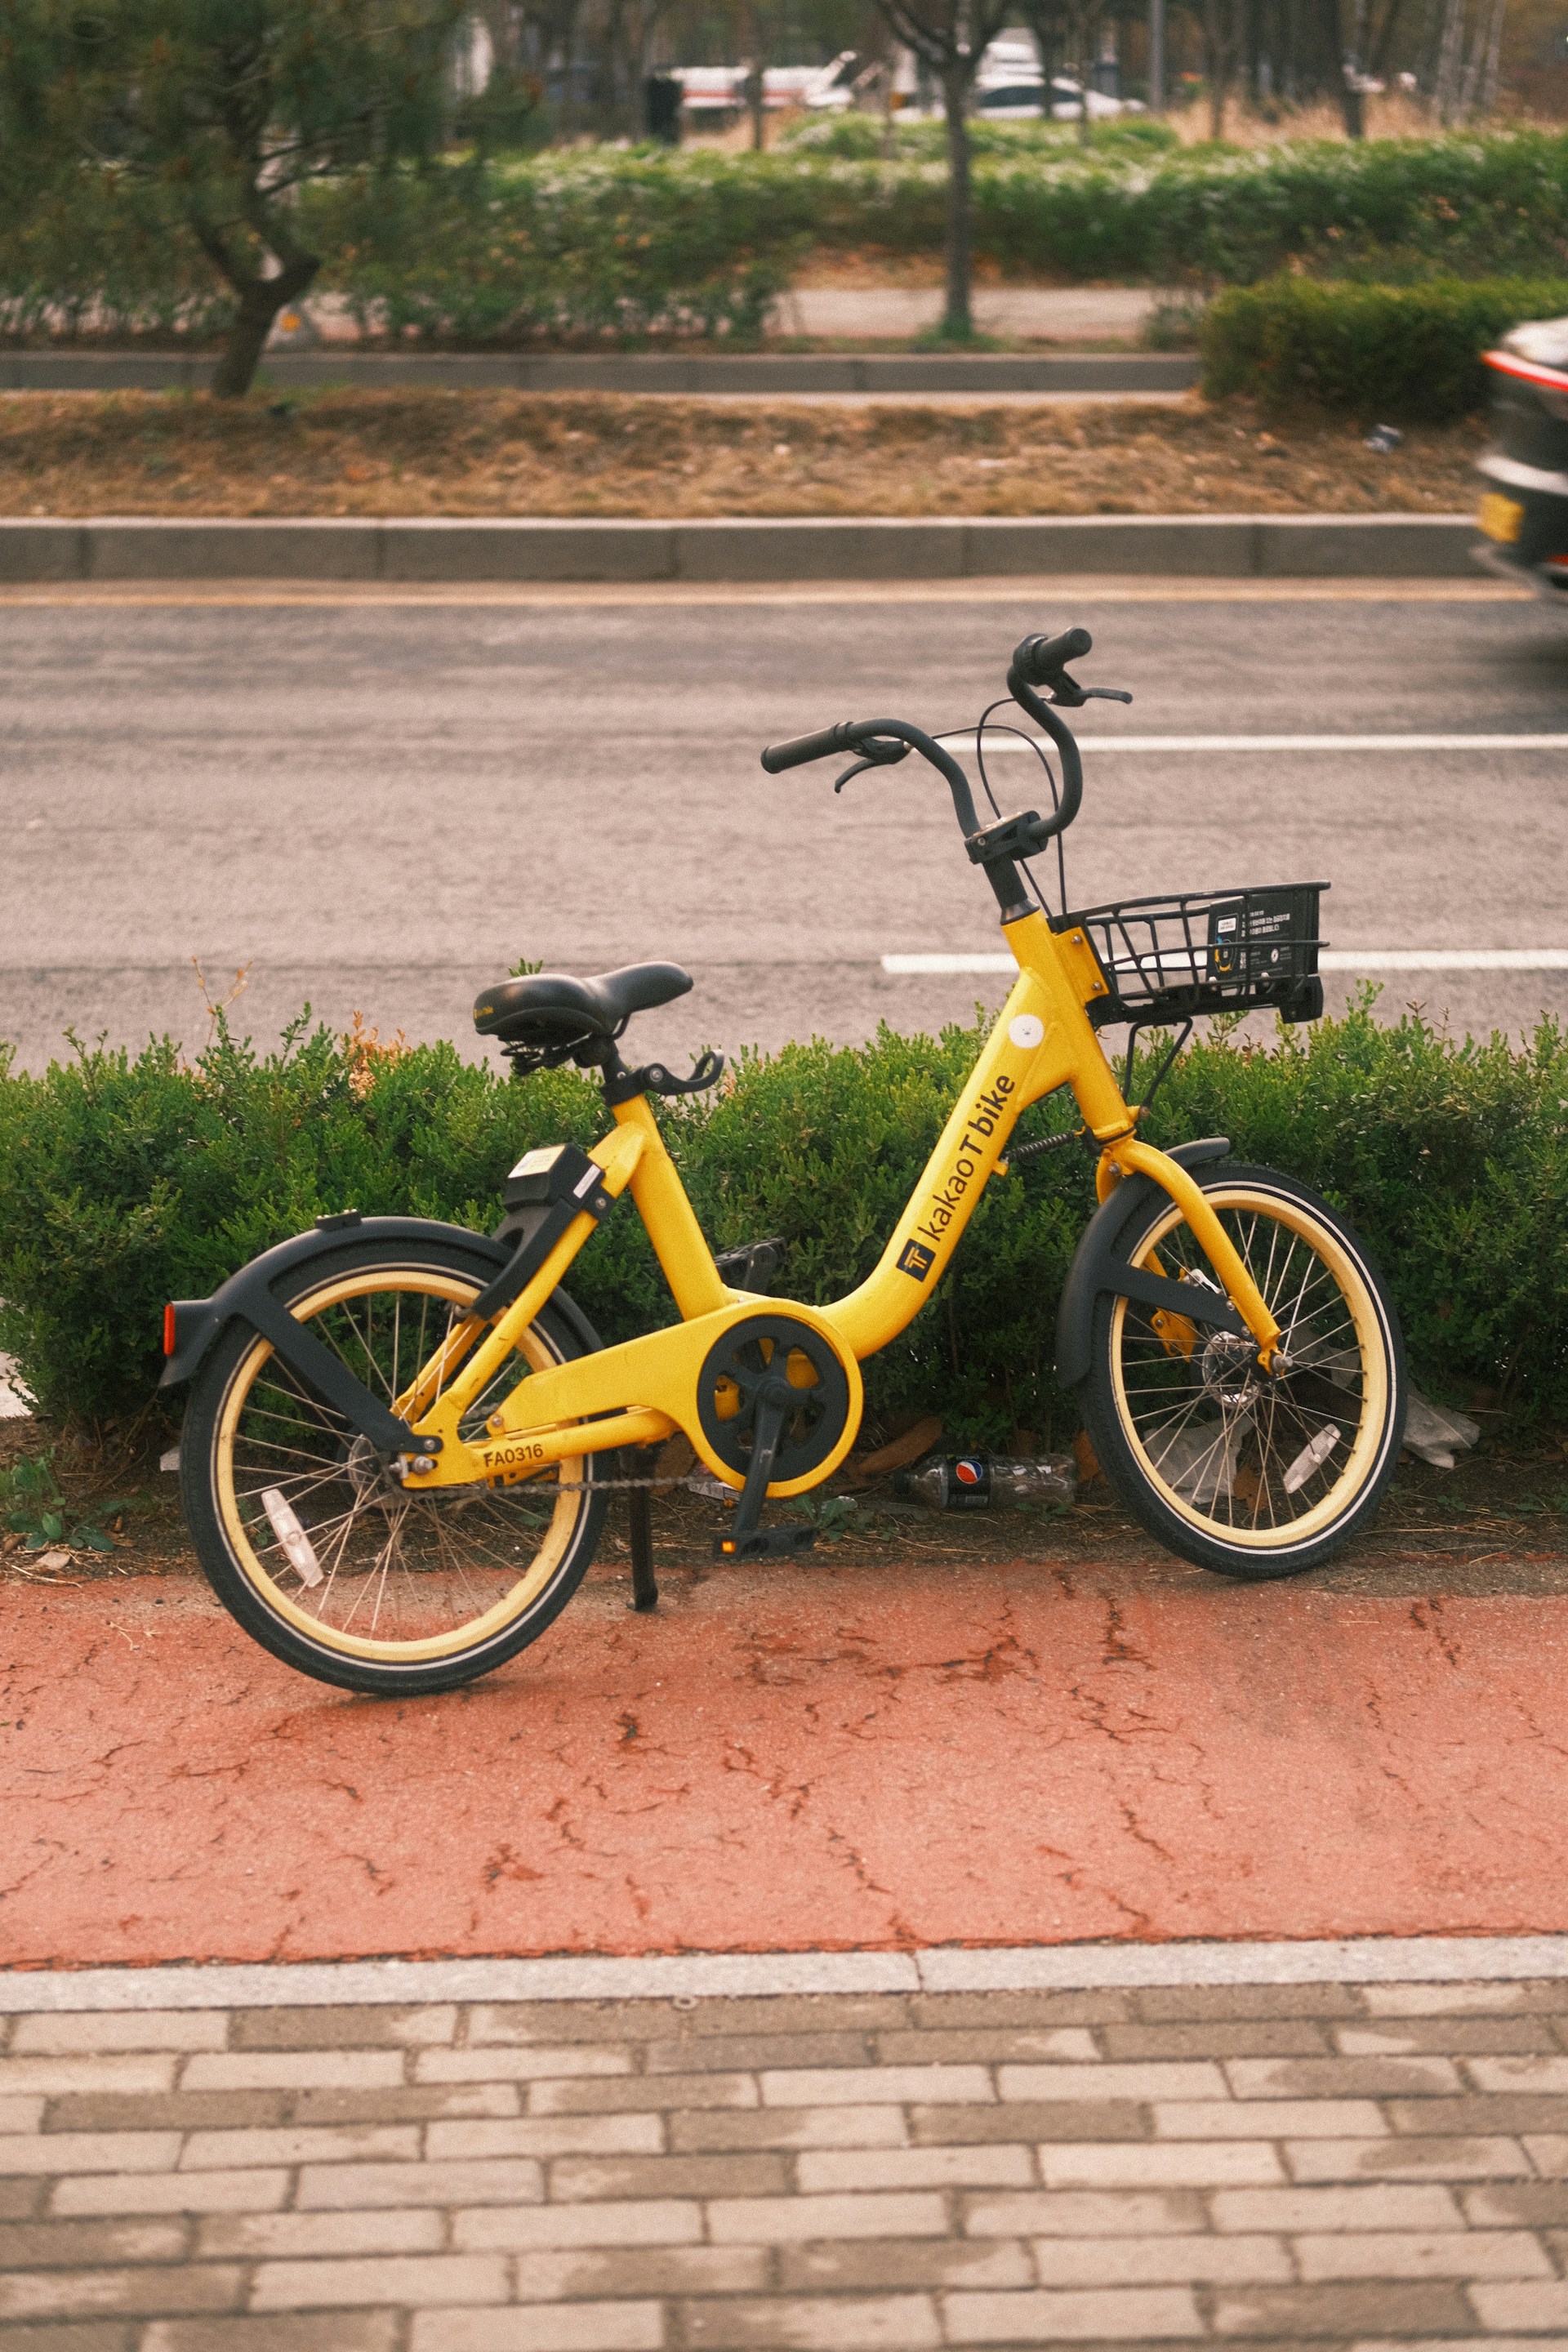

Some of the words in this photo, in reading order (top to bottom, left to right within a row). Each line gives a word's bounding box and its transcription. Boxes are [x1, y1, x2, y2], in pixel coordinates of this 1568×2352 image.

[967, 1075, 1015, 1137] bike
[959, 1134, 984, 1156] T
[917, 1159, 975, 1242] kakao
[483, 1443, 543, 1468] FA0316
